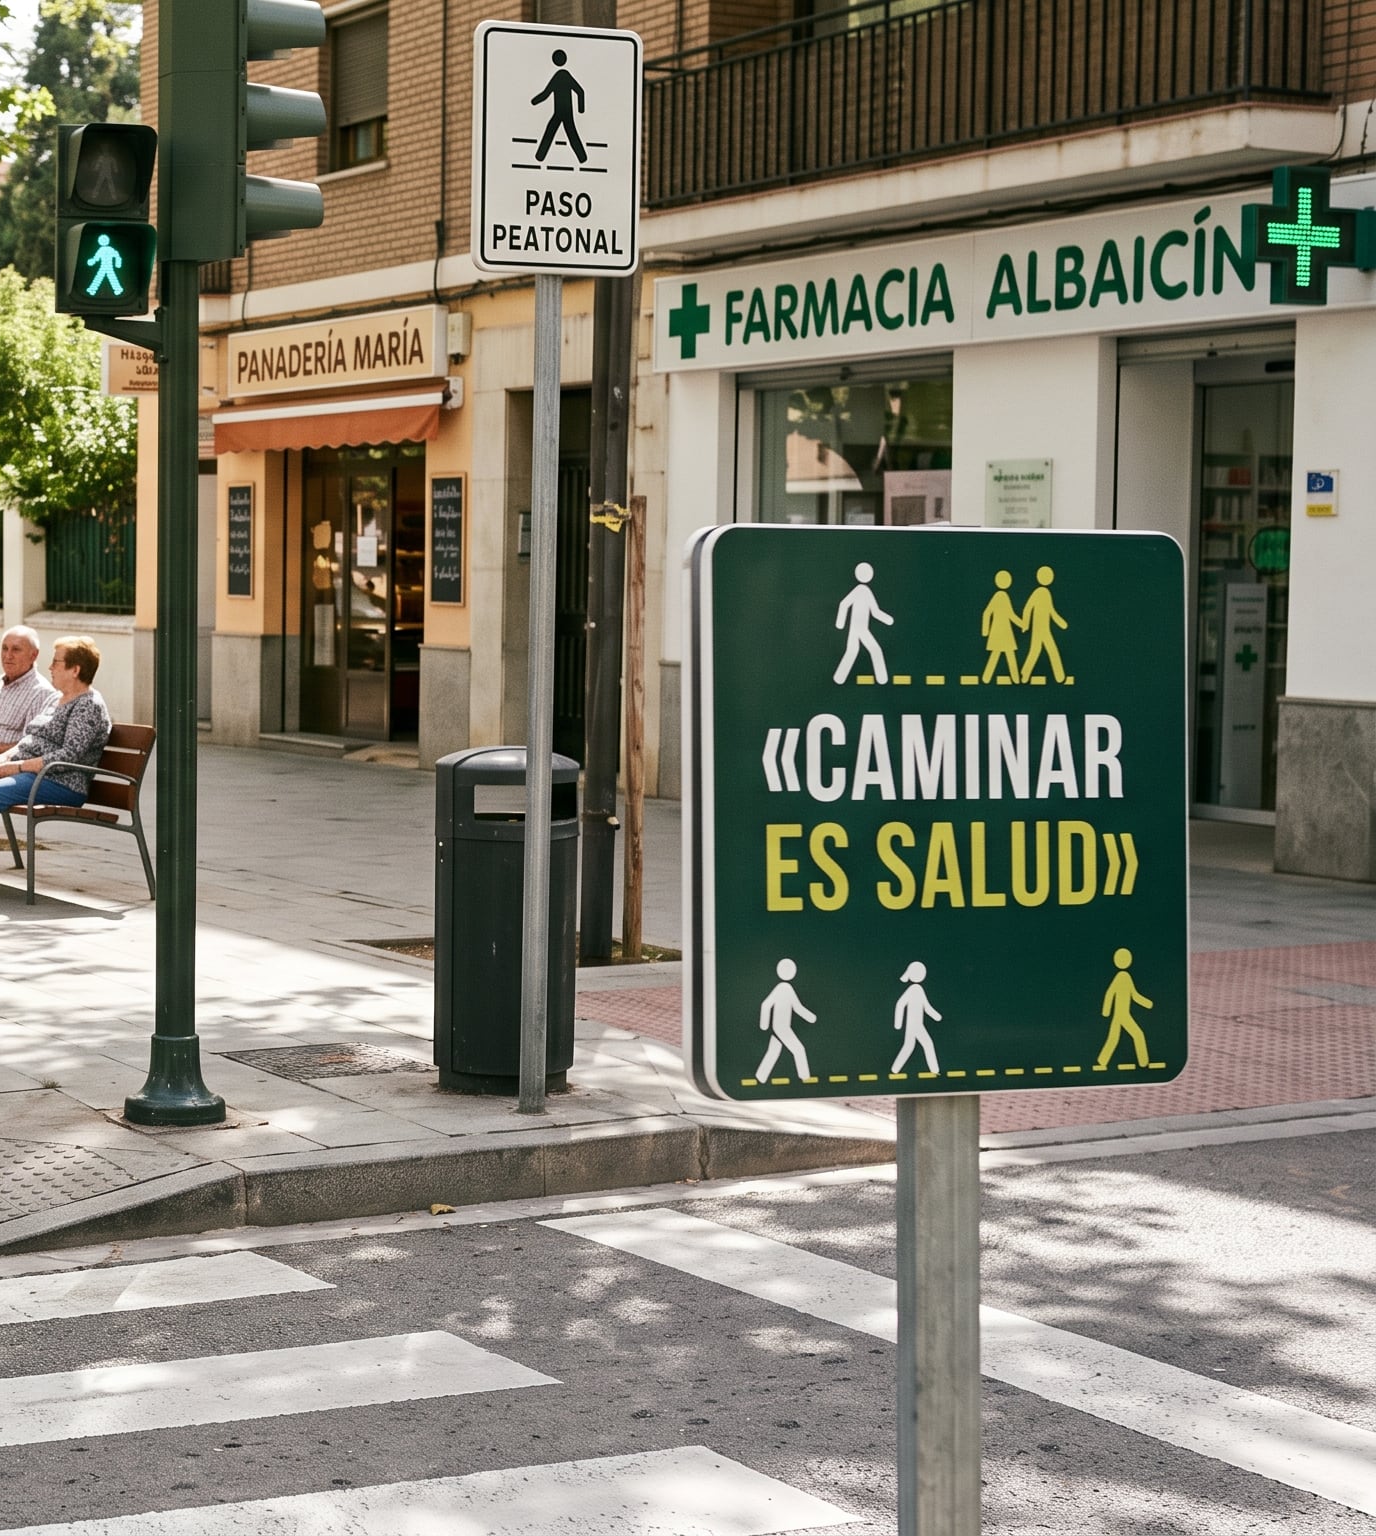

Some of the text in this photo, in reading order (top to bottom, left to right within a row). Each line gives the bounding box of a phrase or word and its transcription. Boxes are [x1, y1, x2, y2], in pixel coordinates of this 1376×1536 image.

[492, 223, 624, 255] PEATONAL
[525, 189, 593, 218] PASO
[725, 205, 1256, 346] FARMACIA ALBAICÍN
[237, 319, 425, 385] PANADERÍA MARÍA
[762, 713, 1124, 802] «CAMINAR
[766, 820, 1139, 912] ES SALUD»
